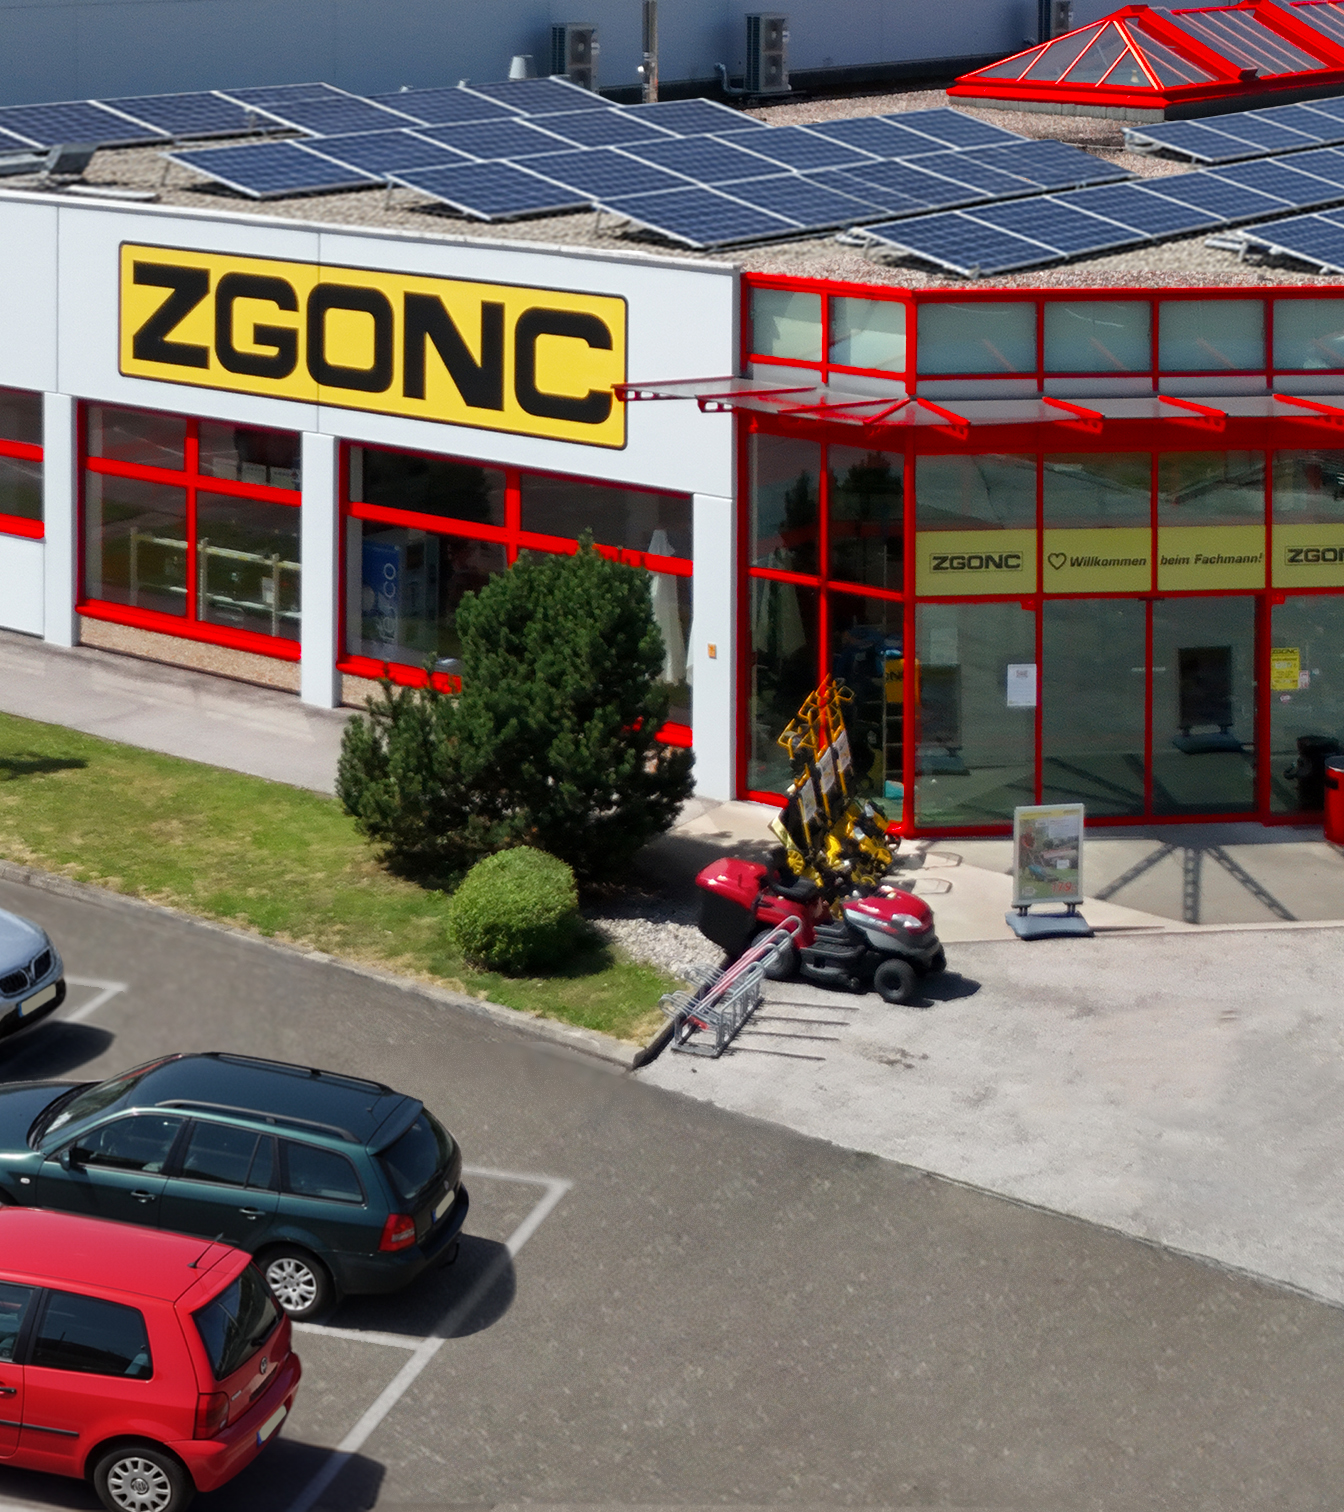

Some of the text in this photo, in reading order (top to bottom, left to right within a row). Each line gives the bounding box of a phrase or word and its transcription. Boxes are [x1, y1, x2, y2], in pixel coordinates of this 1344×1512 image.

[133, 260, 614, 425] ZGONC
[932, 554, 1021, 571] ZGONC
[1069, 551, 1262, 568] Willkommen beim Fachmann!
